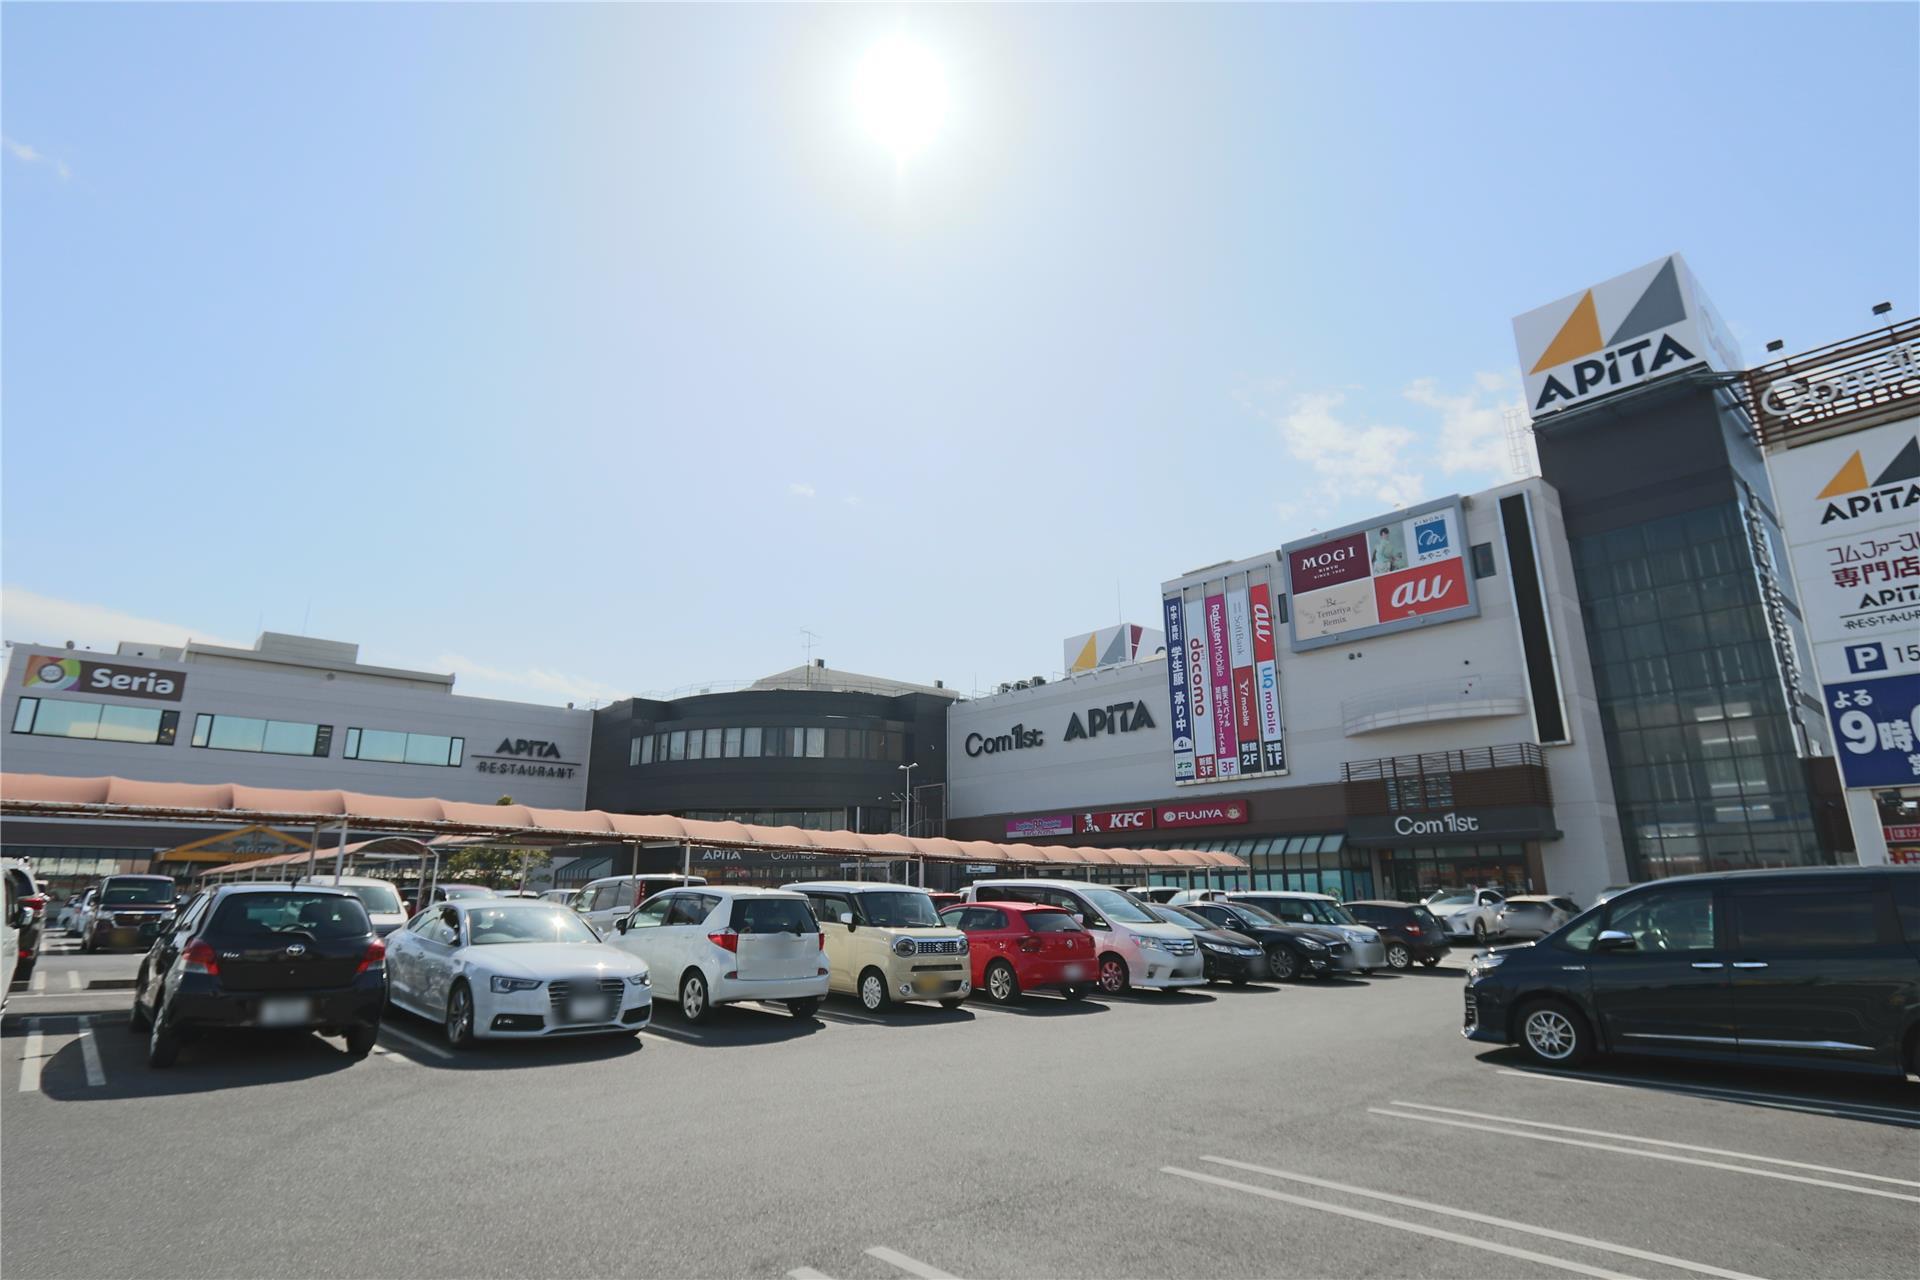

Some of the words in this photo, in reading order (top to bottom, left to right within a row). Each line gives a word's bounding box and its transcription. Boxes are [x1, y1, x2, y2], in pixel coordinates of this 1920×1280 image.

[1302, 546, 1356, 570] MOGI
[1832, 556, 1920, 588] 専門店
[1391, 575, 1453, 608] au
[1859, 584, 1920, 609] APiT
[1210, 604, 1222, 645] Rakuten
[1235, 615, 1244, 656] SoftBank
[1254, 603, 1271, 643] au
[1215, 645, 1226, 677] Mobile
[1854, 647, 1878, 669] P
[91, 668, 175, 694] Seria
[1190, 638, 1204, 716] docomo
[1262, 667, 1273, 688] UQ
[1174, 691, 1187, 731] 承り中
[1834, 689, 1873, 708] よる
[1265, 691, 1276, 734] mobile
[965, 723, 1044, 757] Com1st
[1840, 704, 1920, 754] 9時
[1200, 766, 1213, 776] 3F
[1221, 761, 1234, 775] 3F
[1243, 753, 1258, 765] 2F
[1267, 752, 1282, 766] 1F
[1109, 812, 1145, 829] KFC
[1178, 809, 1223, 820] FUJIYA
[1395, 813, 1479, 835] Com1st
